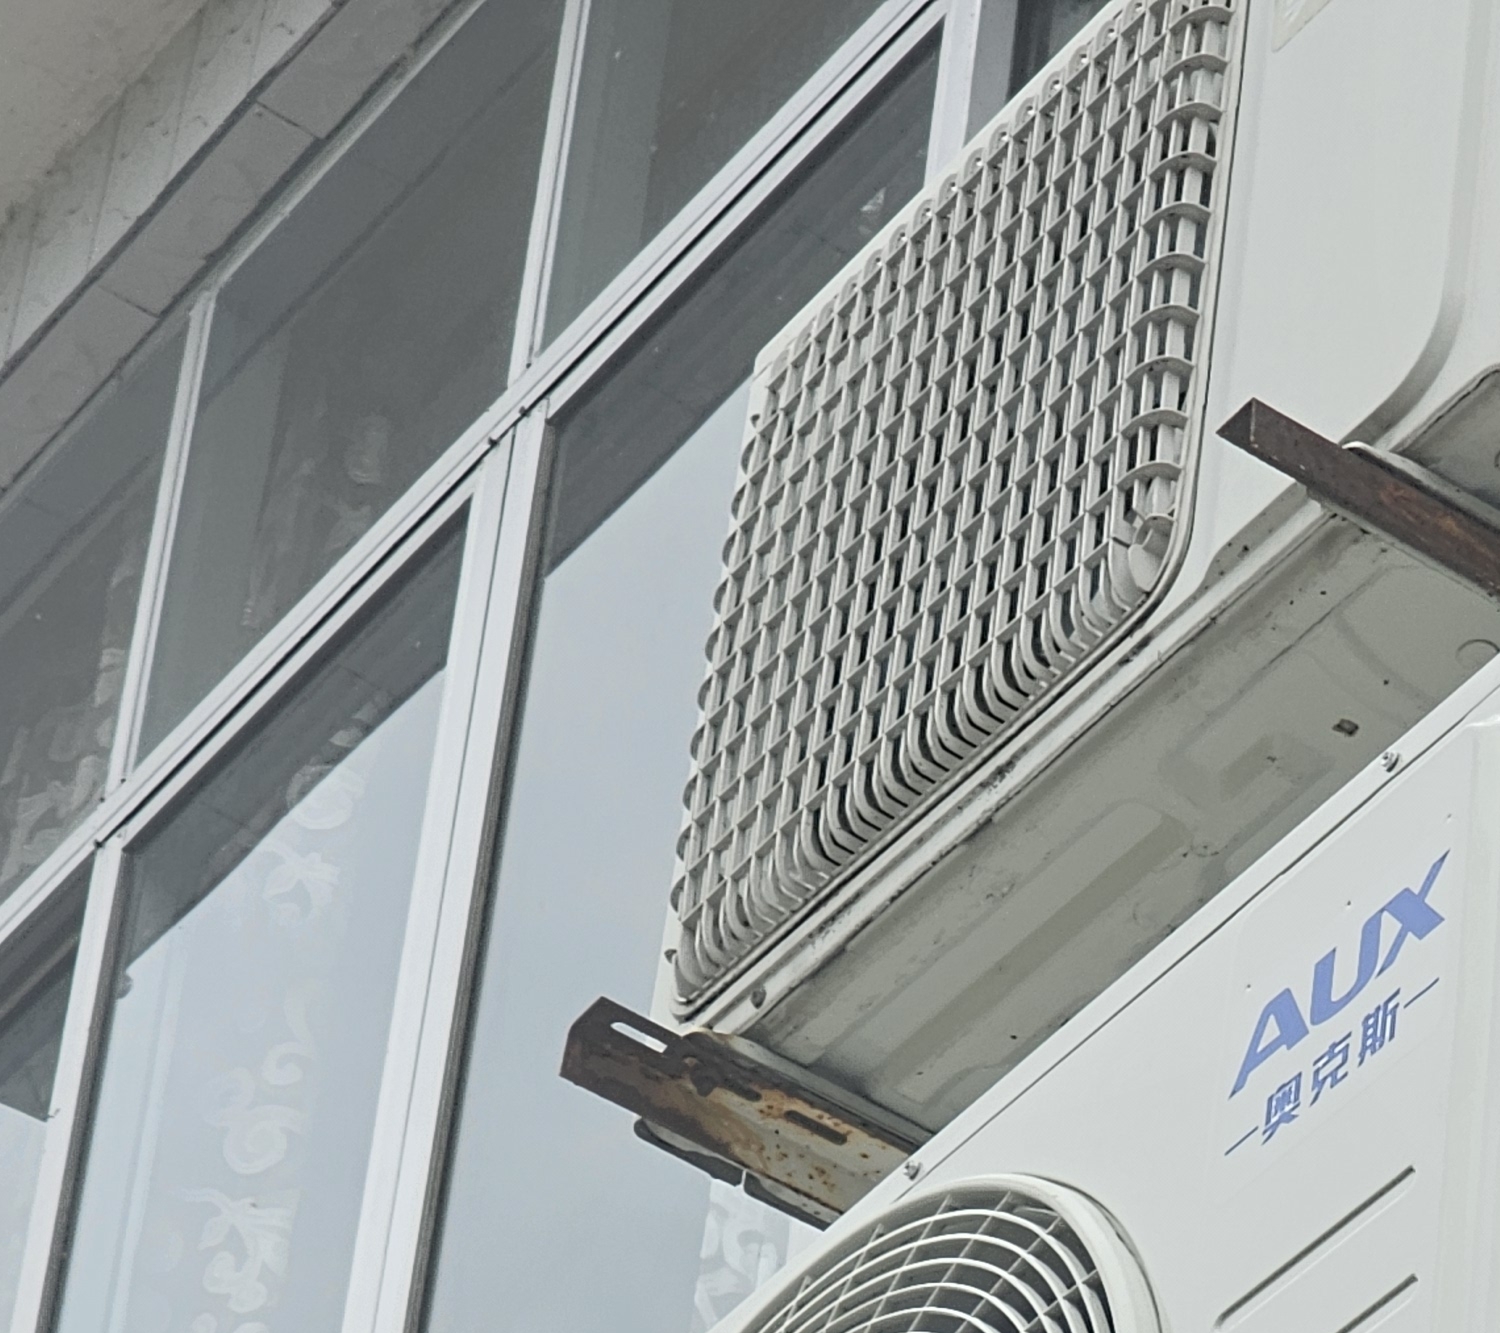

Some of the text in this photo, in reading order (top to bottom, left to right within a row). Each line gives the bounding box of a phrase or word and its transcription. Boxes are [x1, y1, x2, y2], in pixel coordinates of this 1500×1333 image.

[1227, 847, 1451, 1100] AUX
[1261, 987, 1402, 1146] 奥克斯
